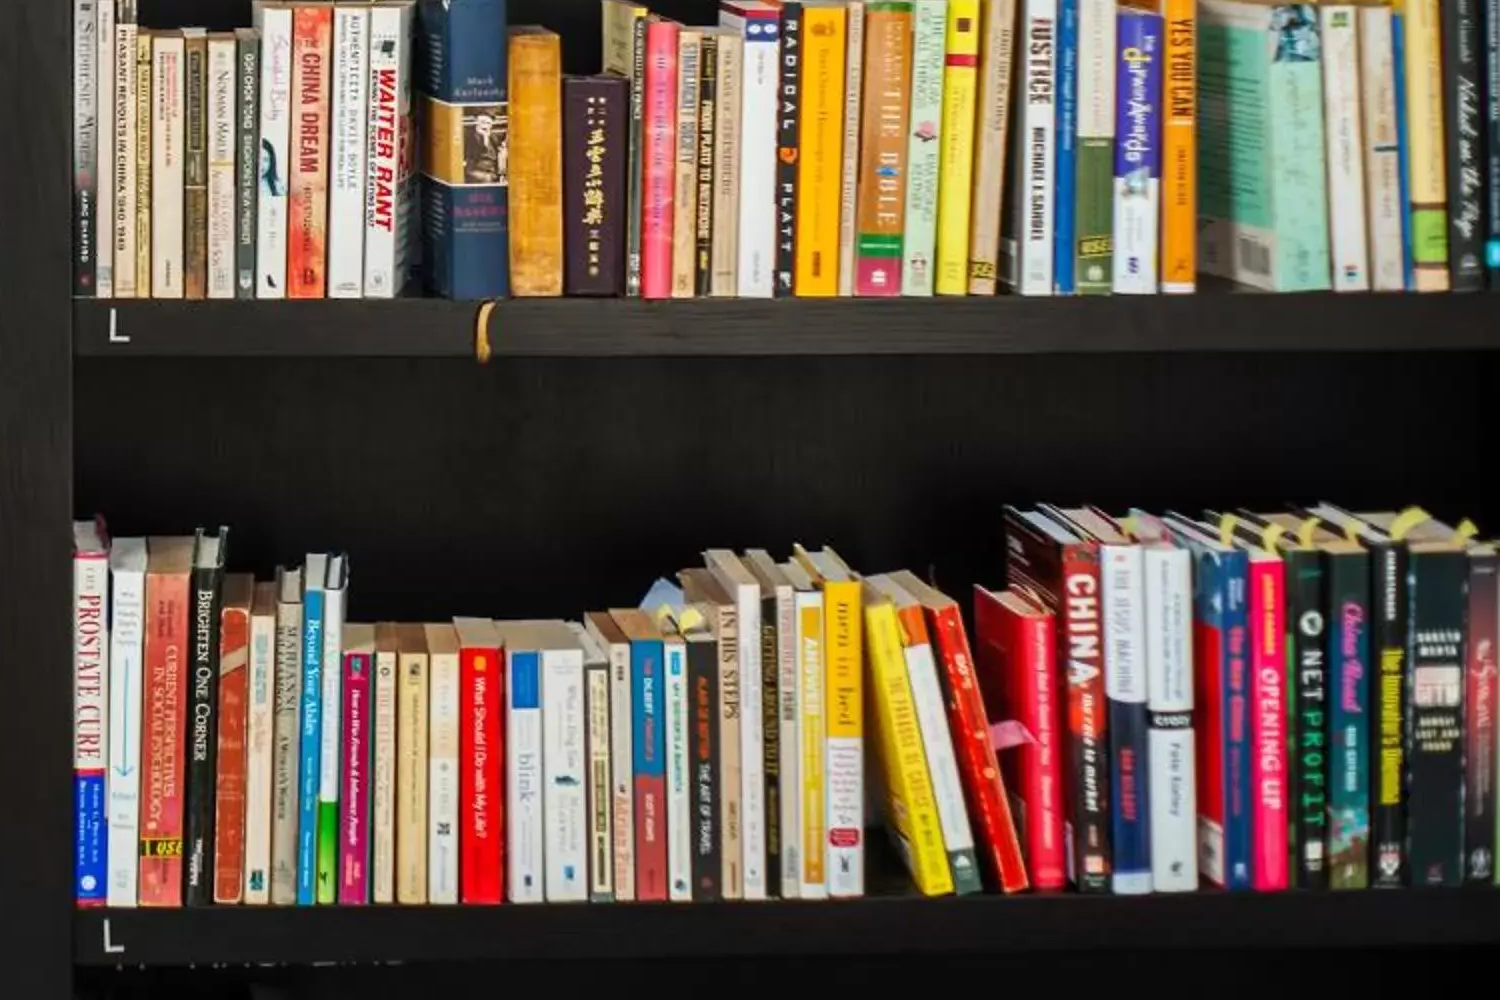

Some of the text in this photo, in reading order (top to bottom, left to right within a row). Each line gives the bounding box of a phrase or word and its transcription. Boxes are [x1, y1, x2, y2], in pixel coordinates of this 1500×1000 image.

[116, 29, 127, 193] PEASANT REVOLTS IN CHINA
[300, 53, 321, 173] CHINA DREAM
[1029, 17, 1053, 178] JUSTICE MICHAEL
[1170, 18, 1193, 117] YES YOU CAN
[375, 69, 397, 233] WAITER RANT
[781, 19, 798, 253] RADICAL PLATT
[1457, 75, 1479, 195] Naked the
[109, 307, 131, 343] L
[76, 595, 101, 761] PROSTATE CURE
[163, 645, 178, 798] CURRENT PERSPECTIVES
[193, 589, 213, 762] BRIGHTEN ONE CORNER
[305, 619, 320, 694] Beyond Your
[720, 610, 739, 720] IN HIS STEPS
[836, 686, 857, 727] bed
[472, 677, 486, 839] What Should Do with My Life?
[517, 753, 534, 805] blink
[1261, 667, 1281, 811] OPENING UP
[1302, 650, 1324, 826] NET PROFIT
[699, 763, 711, 855] THE ART OF TRAVEL
[103, 918, 125, 953] L
